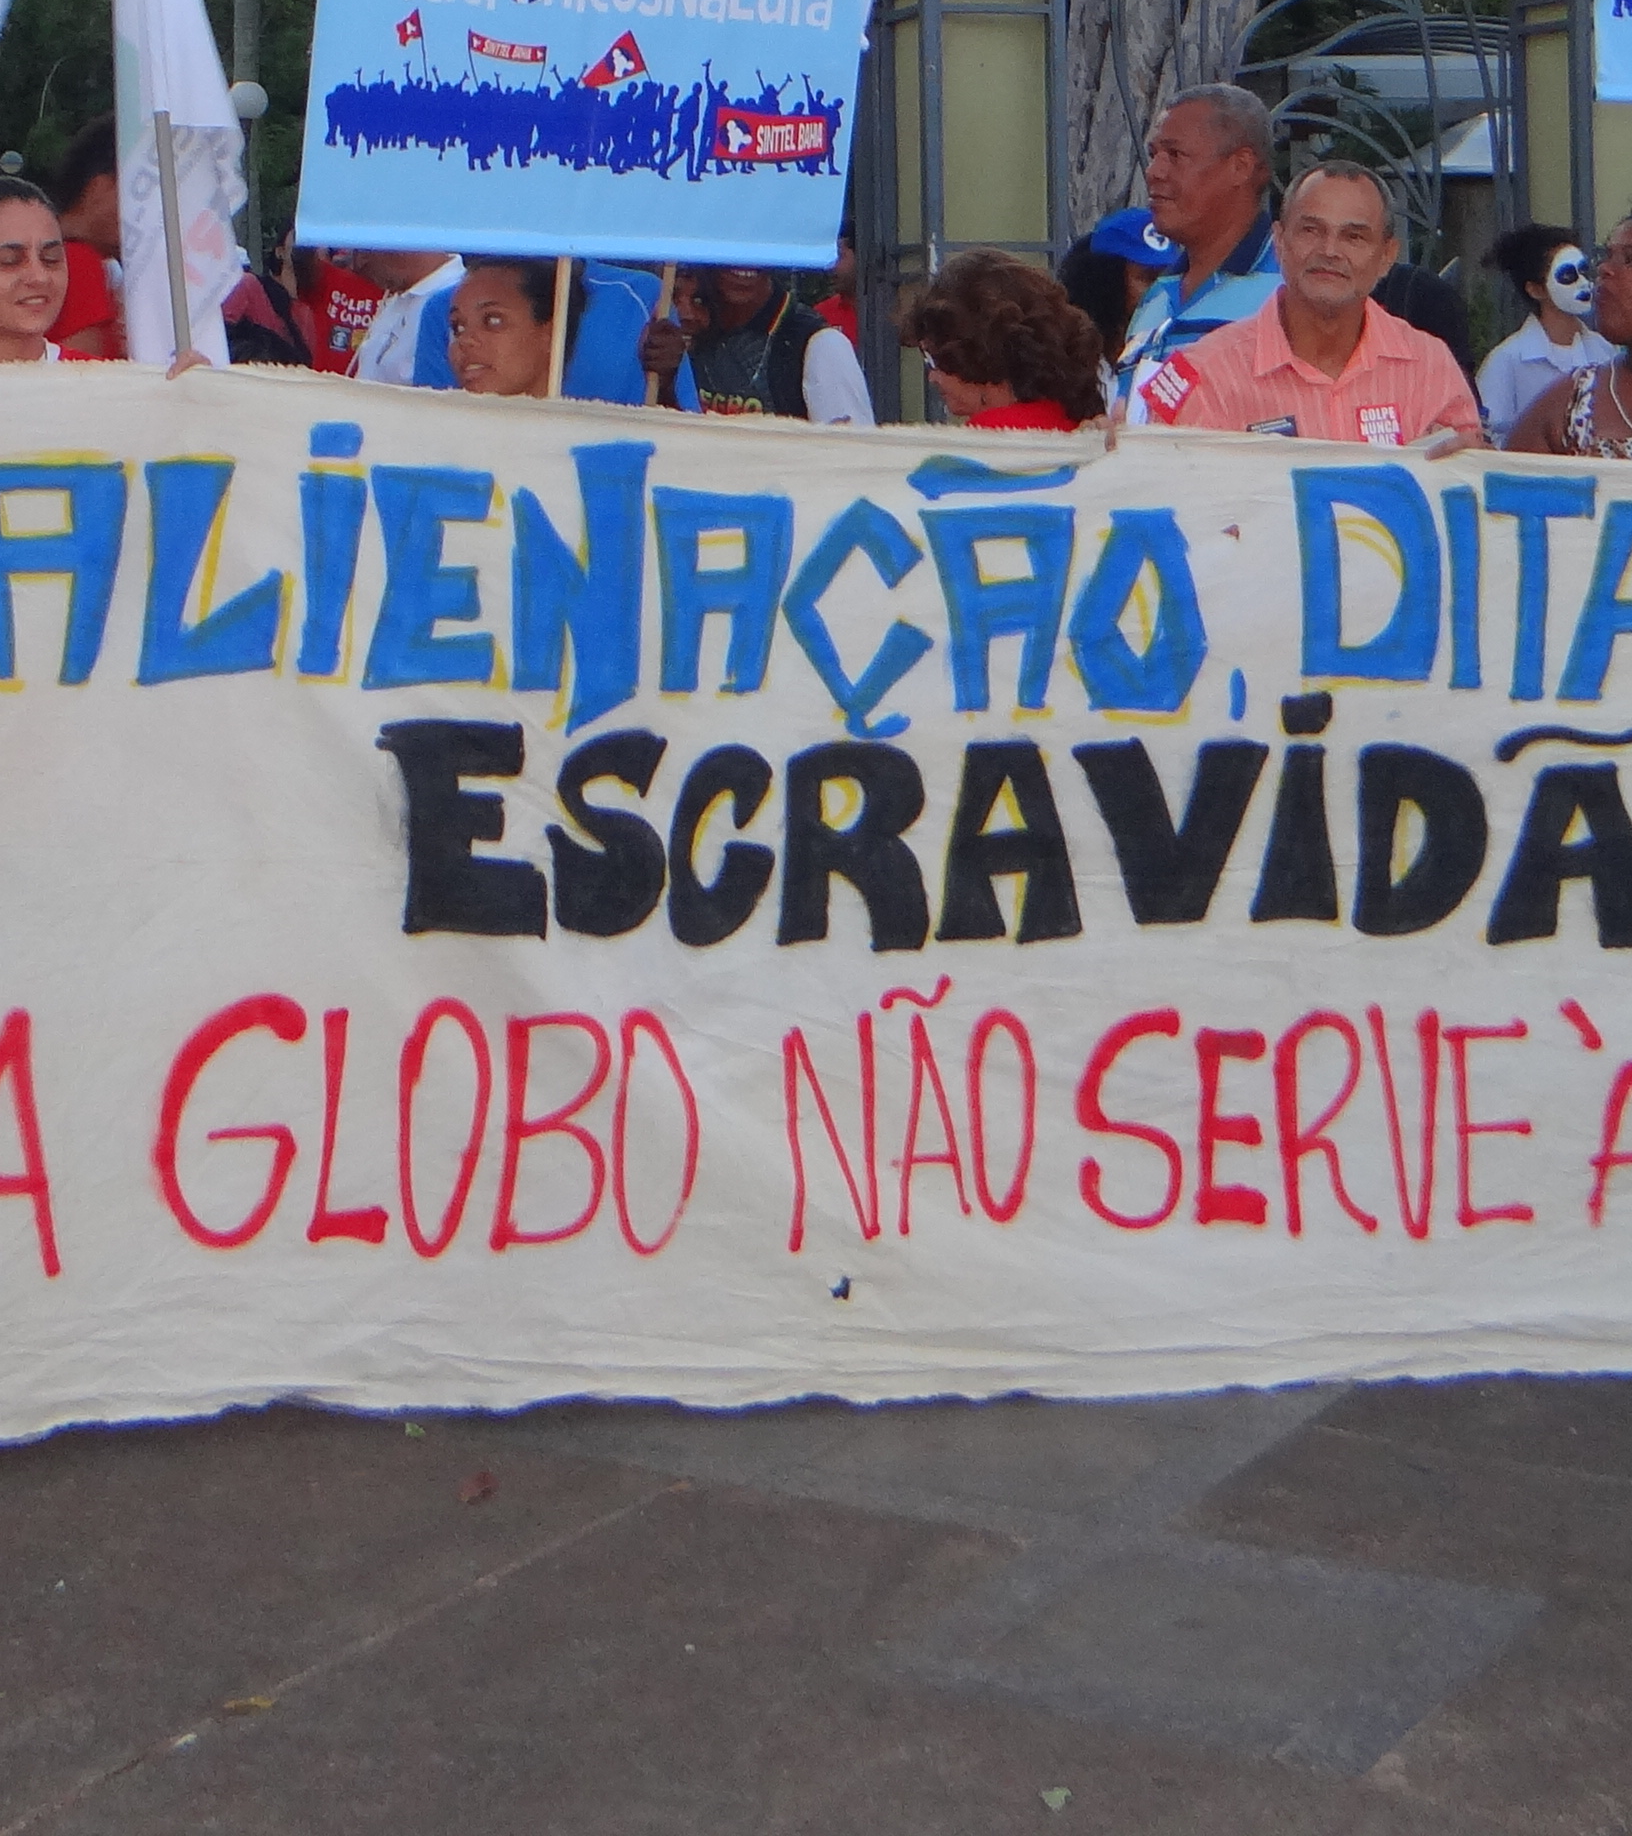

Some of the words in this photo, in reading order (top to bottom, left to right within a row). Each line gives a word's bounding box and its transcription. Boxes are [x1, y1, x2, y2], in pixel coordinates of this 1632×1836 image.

[756, 123, 796, 155] SINTTEL
[797, 121, 824, 152] BAHIA
[331, 289, 374, 313] GOLPE
[1360, 406, 1396, 422] GOLPE
[1360, 419, 1401, 436] NUNCA
[151, 993, 701, 1260] GLOBO
[782, 975, 1037, 1254] NÃO
[1075, 1005, 1536, 1241] SERVE
